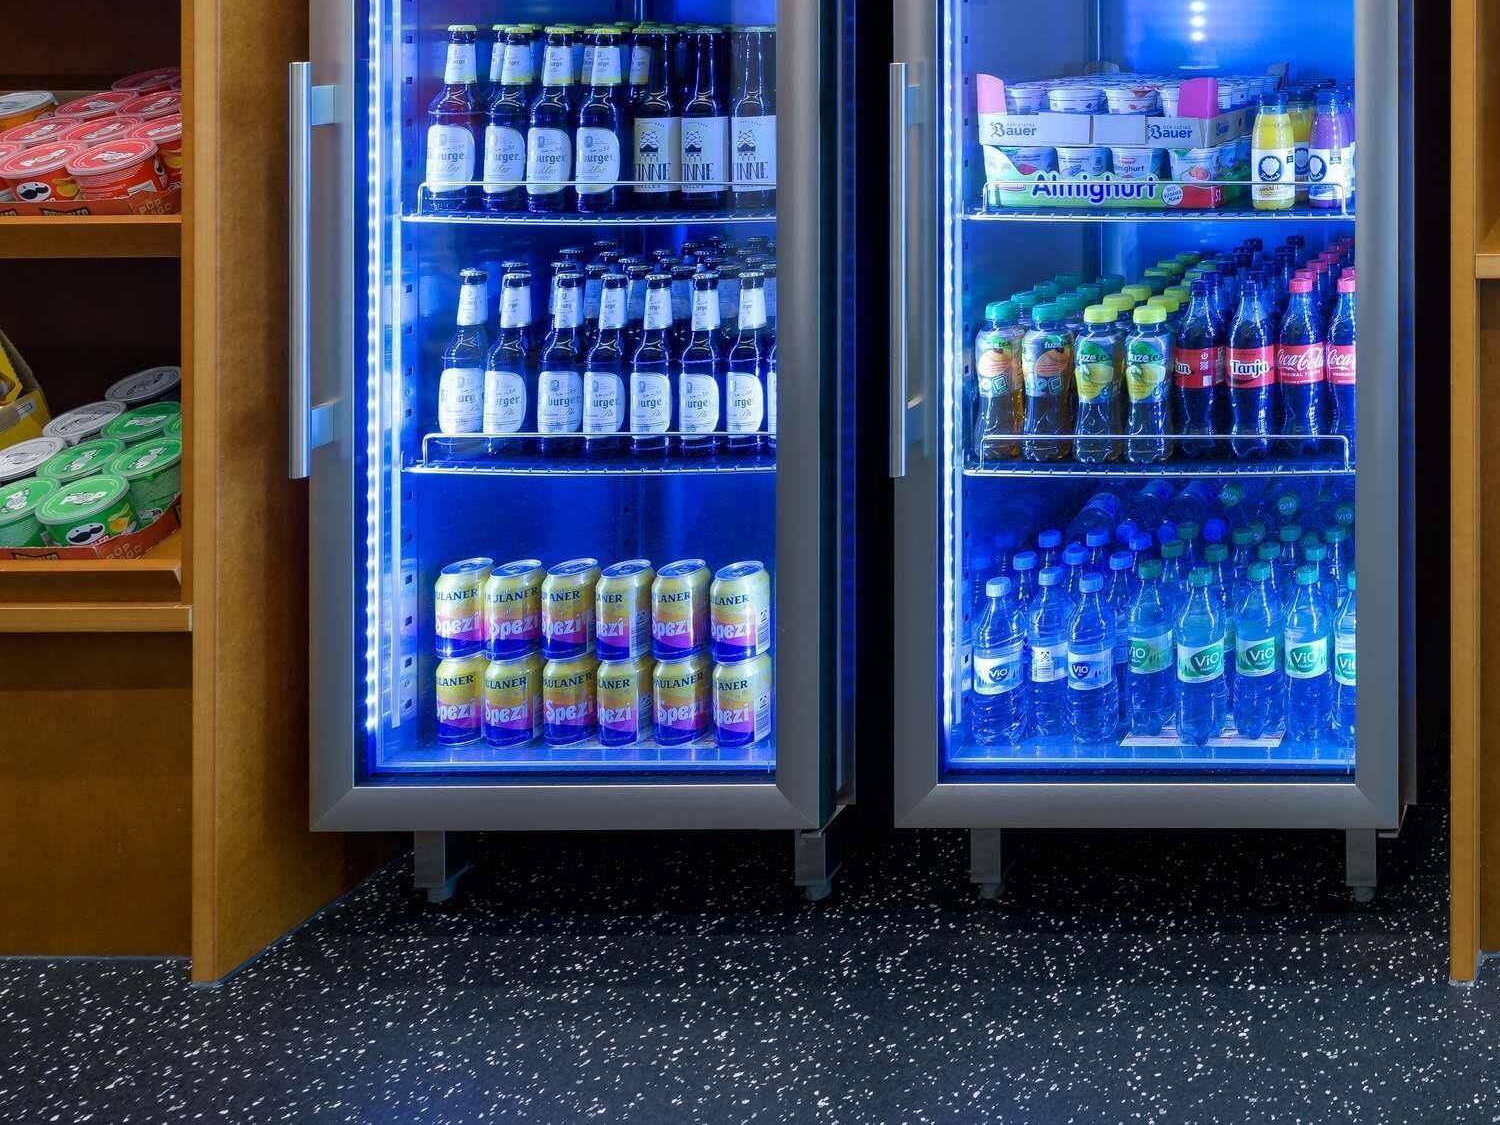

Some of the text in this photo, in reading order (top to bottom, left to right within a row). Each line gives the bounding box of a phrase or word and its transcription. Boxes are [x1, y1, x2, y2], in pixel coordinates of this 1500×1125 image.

[991, 122, 1038, 138] Bauer
[1147, 124, 1193, 139] Bauer
[1032, 174, 1158, 204] Almighurt
[1230, 360, 1268, 377] Tanja
[1195, 652, 1220, 667] ViO
[1250, 647, 1275, 661] ViO
[1293, 651, 1317, 663] ViO
